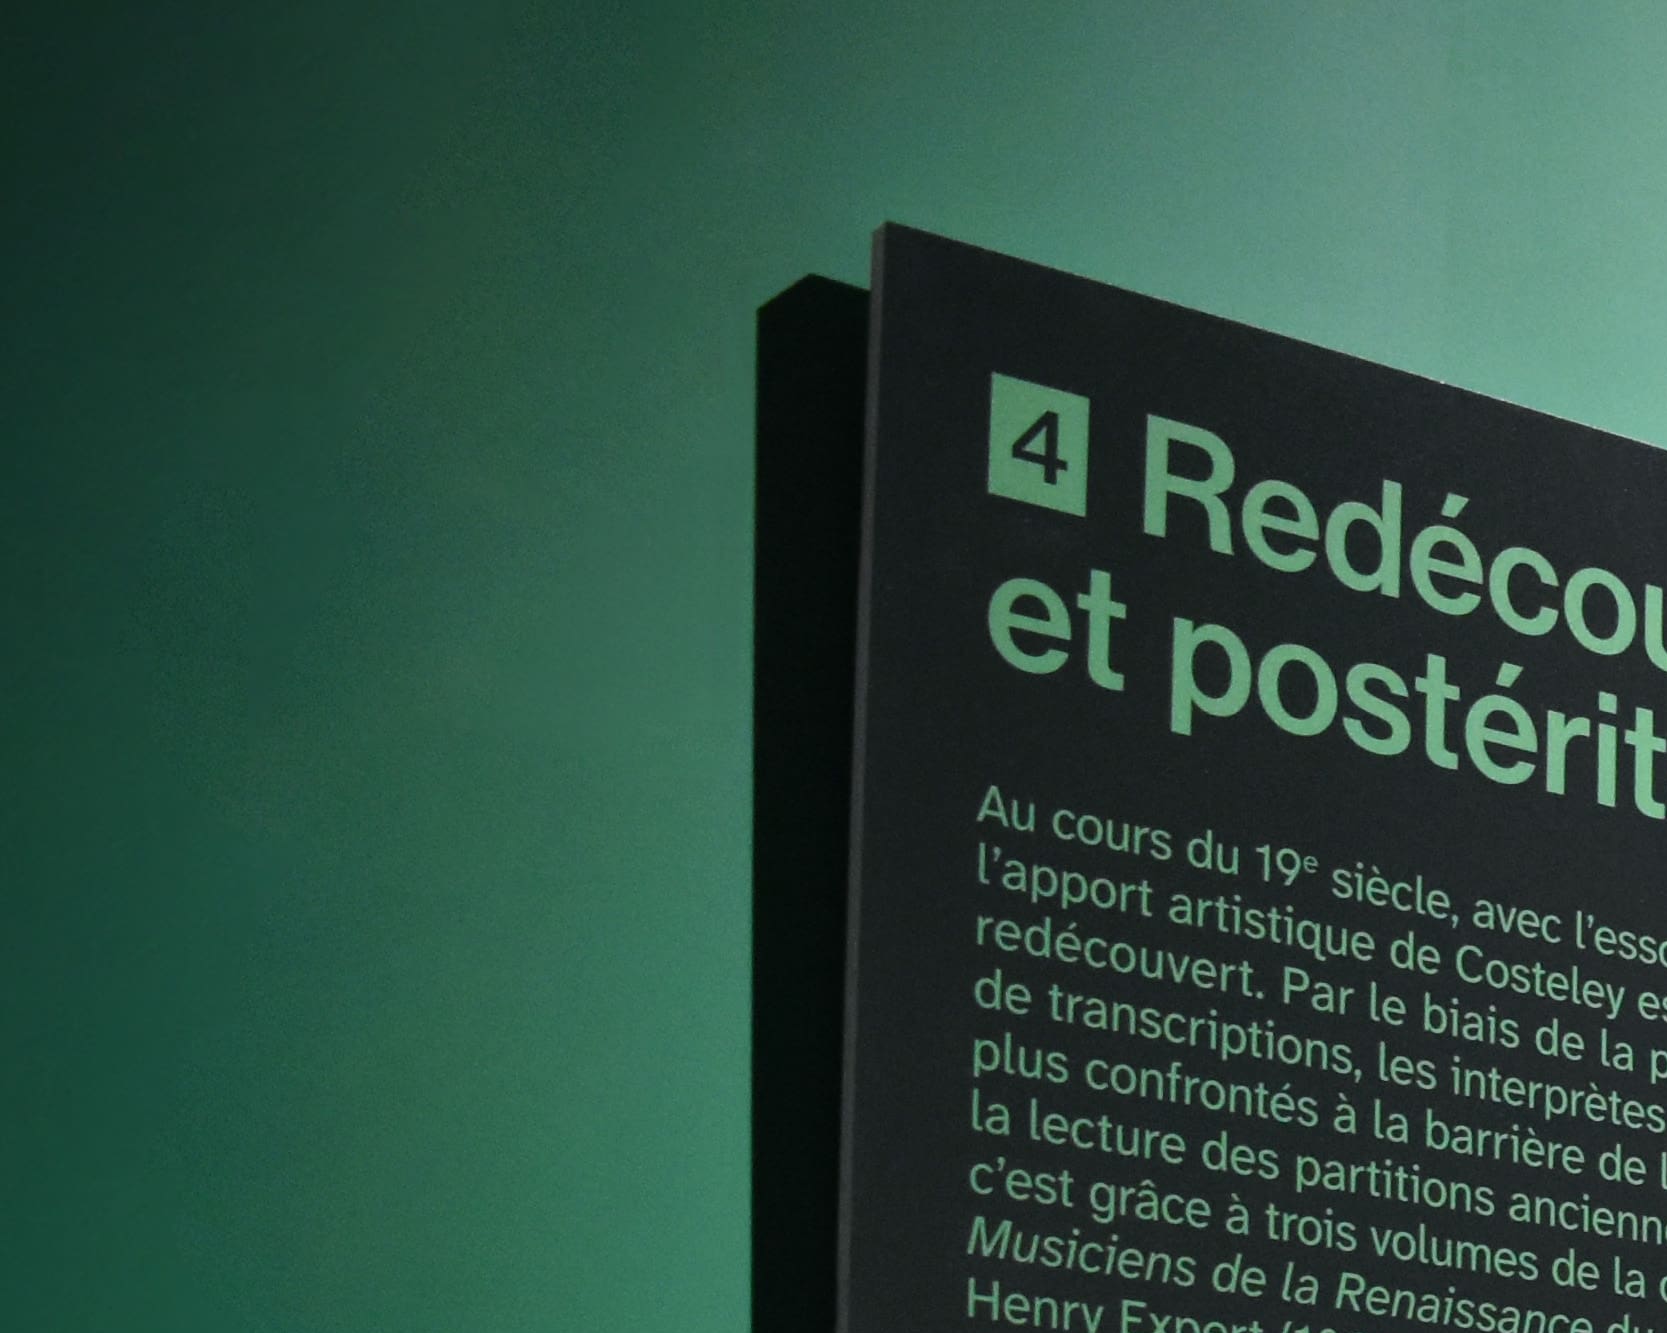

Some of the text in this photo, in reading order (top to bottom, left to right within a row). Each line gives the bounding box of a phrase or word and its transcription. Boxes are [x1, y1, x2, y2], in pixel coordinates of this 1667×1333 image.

[1010, 409, 1069, 487] 4
[987, 568, 1127, 692] et
[975, 784, 1037, 834] Au
[1050, 808, 1173, 862] cours
[1185, 828, 1240, 877] du
[1254, 843, 1320, 888] 19e
[1331, 860, 1460, 930] siècle,
[1471, 898, 1563, 945] avec
[977, 841, 1154, 919] l'apport
[1167, 892, 1377, 963] artistique
[1388, 929, 1442, 976] de
[1454, 943, 1626, 1021] Costeley
[973, 967, 1033, 1016] de
[1047, 982, 1363, 1085] transcriptions,
[1377, 1039, 1438, 1091] les
[1449, 1054, 1667, 1135] interprètes
[976, 914, 1265, 1001] redécouvert.
[1282, 964, 1356, 1016] Par
[1369, 979, 1408, 1027] le
[1422, 990, 1521, 1050] biais
[1534, 1016, 1586, 1062] de
[1599, 1026, 1635, 1073] la
[966, 1214, 1198, 1288] Musiciens
[1211, 1251, 1268, 1299] de
[1280, 1260, 1320, 1307] la
